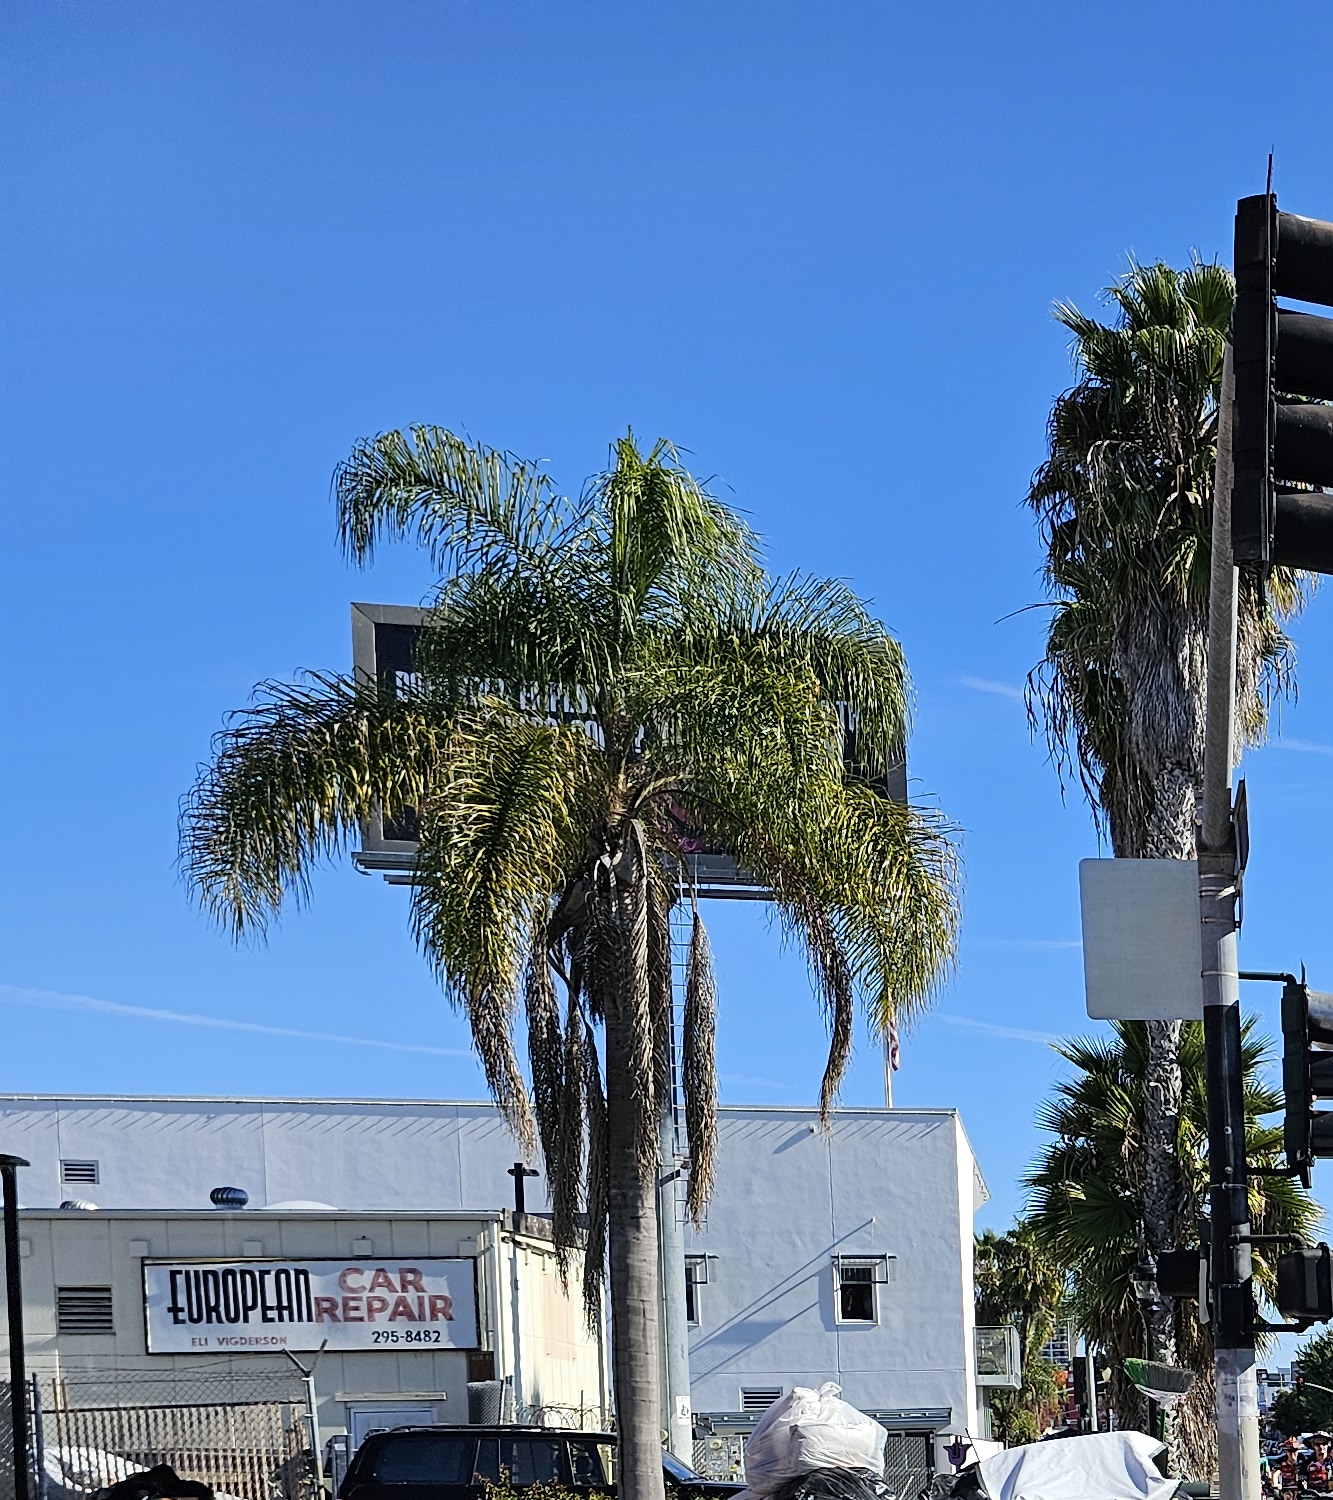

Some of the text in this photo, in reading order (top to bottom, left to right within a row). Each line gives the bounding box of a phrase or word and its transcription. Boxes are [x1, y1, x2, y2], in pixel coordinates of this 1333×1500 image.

[168, 1267, 428, 1325] EUROPEAN CAR
[314, 1294, 456, 1323] REPAIR
[191, 1329, 442, 1347] ELI VIGDERSON 295-8482
